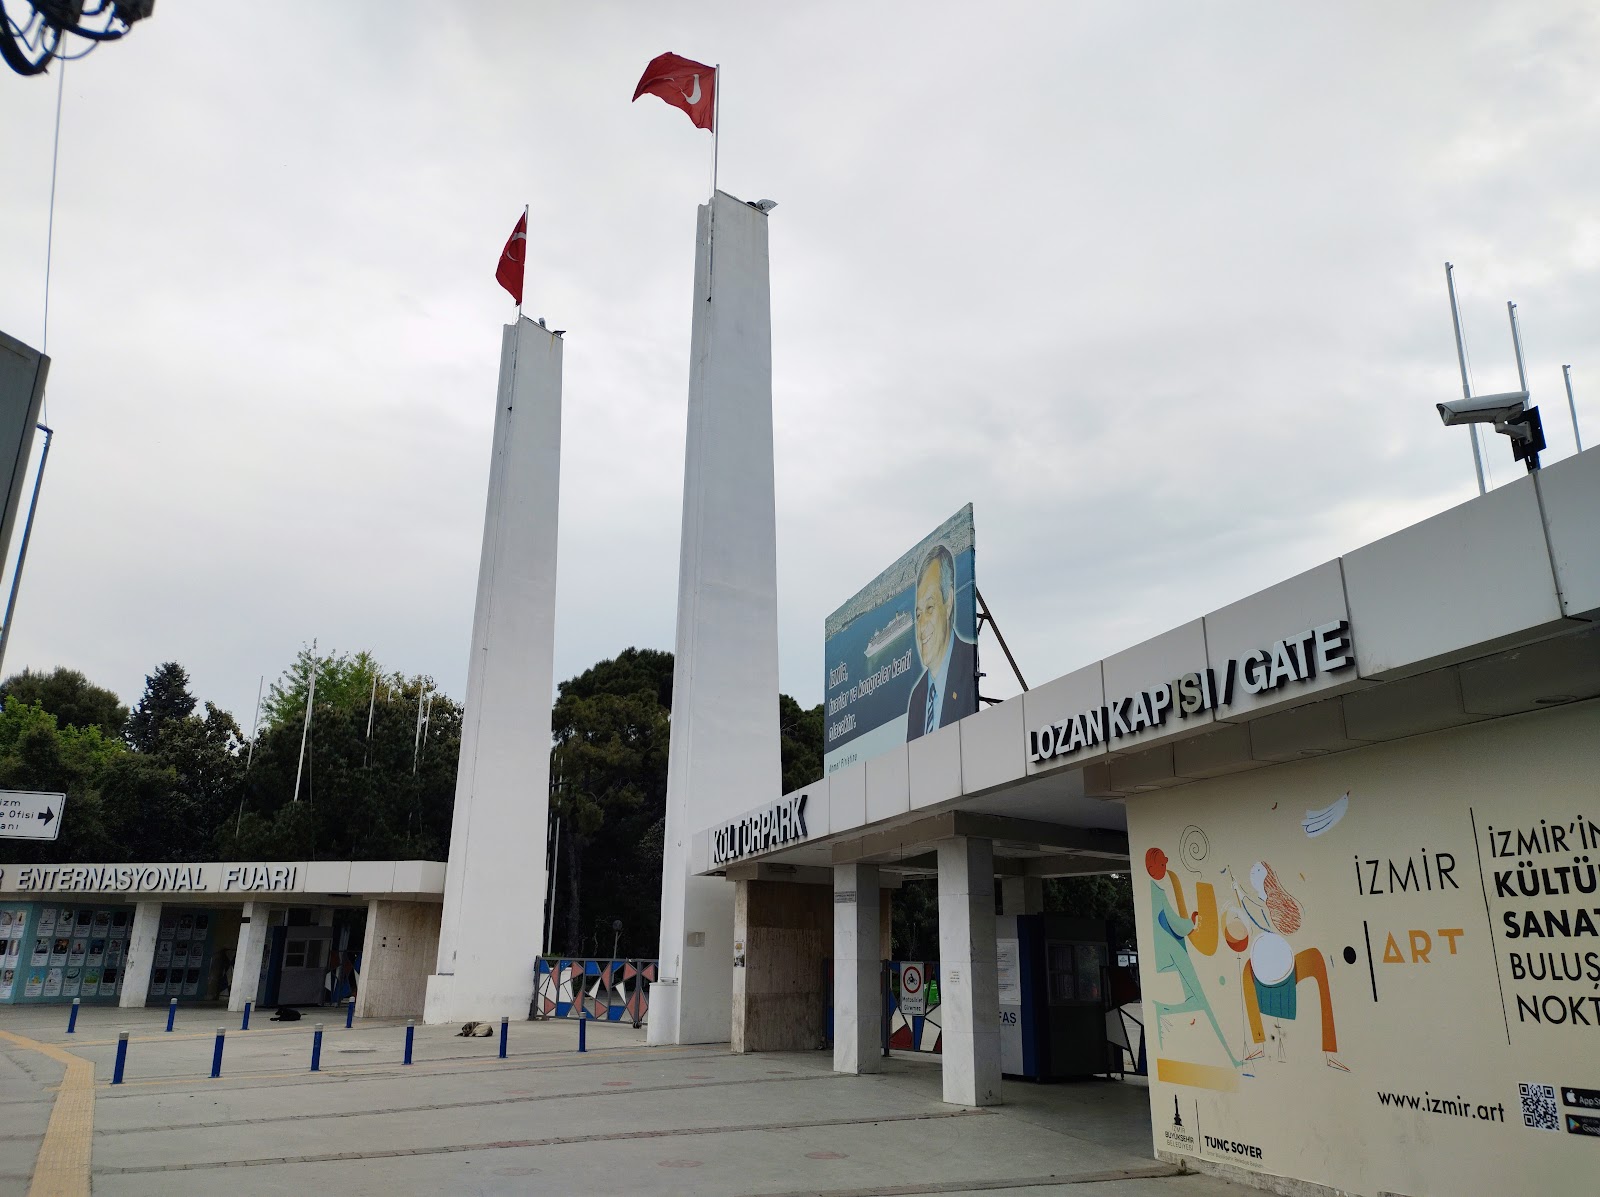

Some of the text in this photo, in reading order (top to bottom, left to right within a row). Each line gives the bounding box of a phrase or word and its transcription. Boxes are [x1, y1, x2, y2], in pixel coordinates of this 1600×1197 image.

[1027, 706, 1108, 763] LOZAN
[9, 810, 35, 819] Ofisi
[16, 867, 208, 891] ENTERNASYONAL
[224, 865, 297, 891] FUARI
[1354, 847, 1459, 896] İZMİR
[1494, 855, 1600, 898] KÜLTÜ
[1383, 928, 1465, 964] ART
[1377, 1091, 1505, 1122] www.izmir.art
[1204, 1136, 1263, 1159] TUNÇ SOYER
